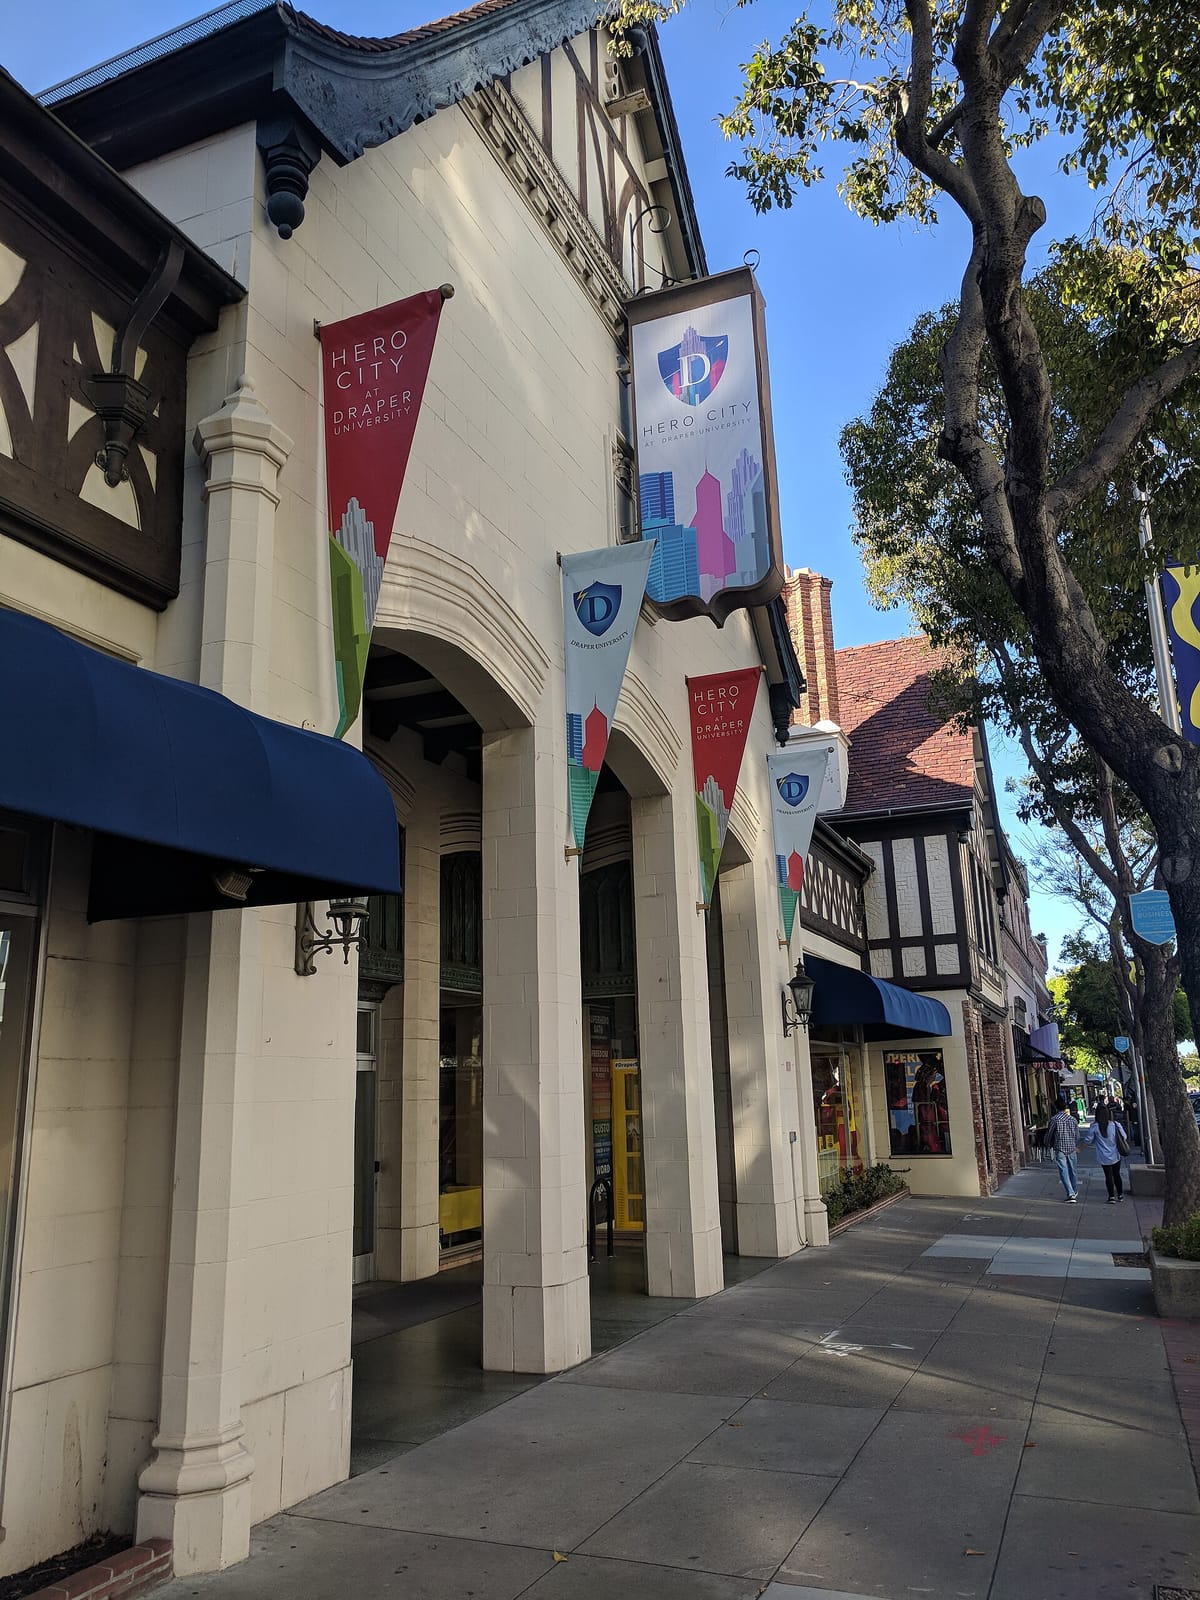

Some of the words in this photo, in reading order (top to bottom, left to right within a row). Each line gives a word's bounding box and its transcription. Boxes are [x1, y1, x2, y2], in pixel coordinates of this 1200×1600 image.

[332, 330, 407, 368] HERO
[336, 355, 404, 389] CITY
[677, 353, 711, 388] D
[365, 388, 380, 399] AT
[333, 391, 411, 424] DRAPER
[333, 406, 411, 436] UNIVERSITY
[643, 415, 694, 437] HERO
[706, 401, 752, 421] CITY
[661, 430, 696, 444] DRAPER
[699, 417, 752, 435] UNIVERSITY
[586, 595, 613, 623] D
[570, 639, 596, 650] DRAPER
[595, 631, 629, 650] UNIVERSITY
[694, 685, 739, 703] HERO
[697, 700, 738, 715] CITY
[696, 720, 744, 734] DRAPER
[696, 729, 743, 741] UNIVERSITY
[786, 781, 804, 799] D
